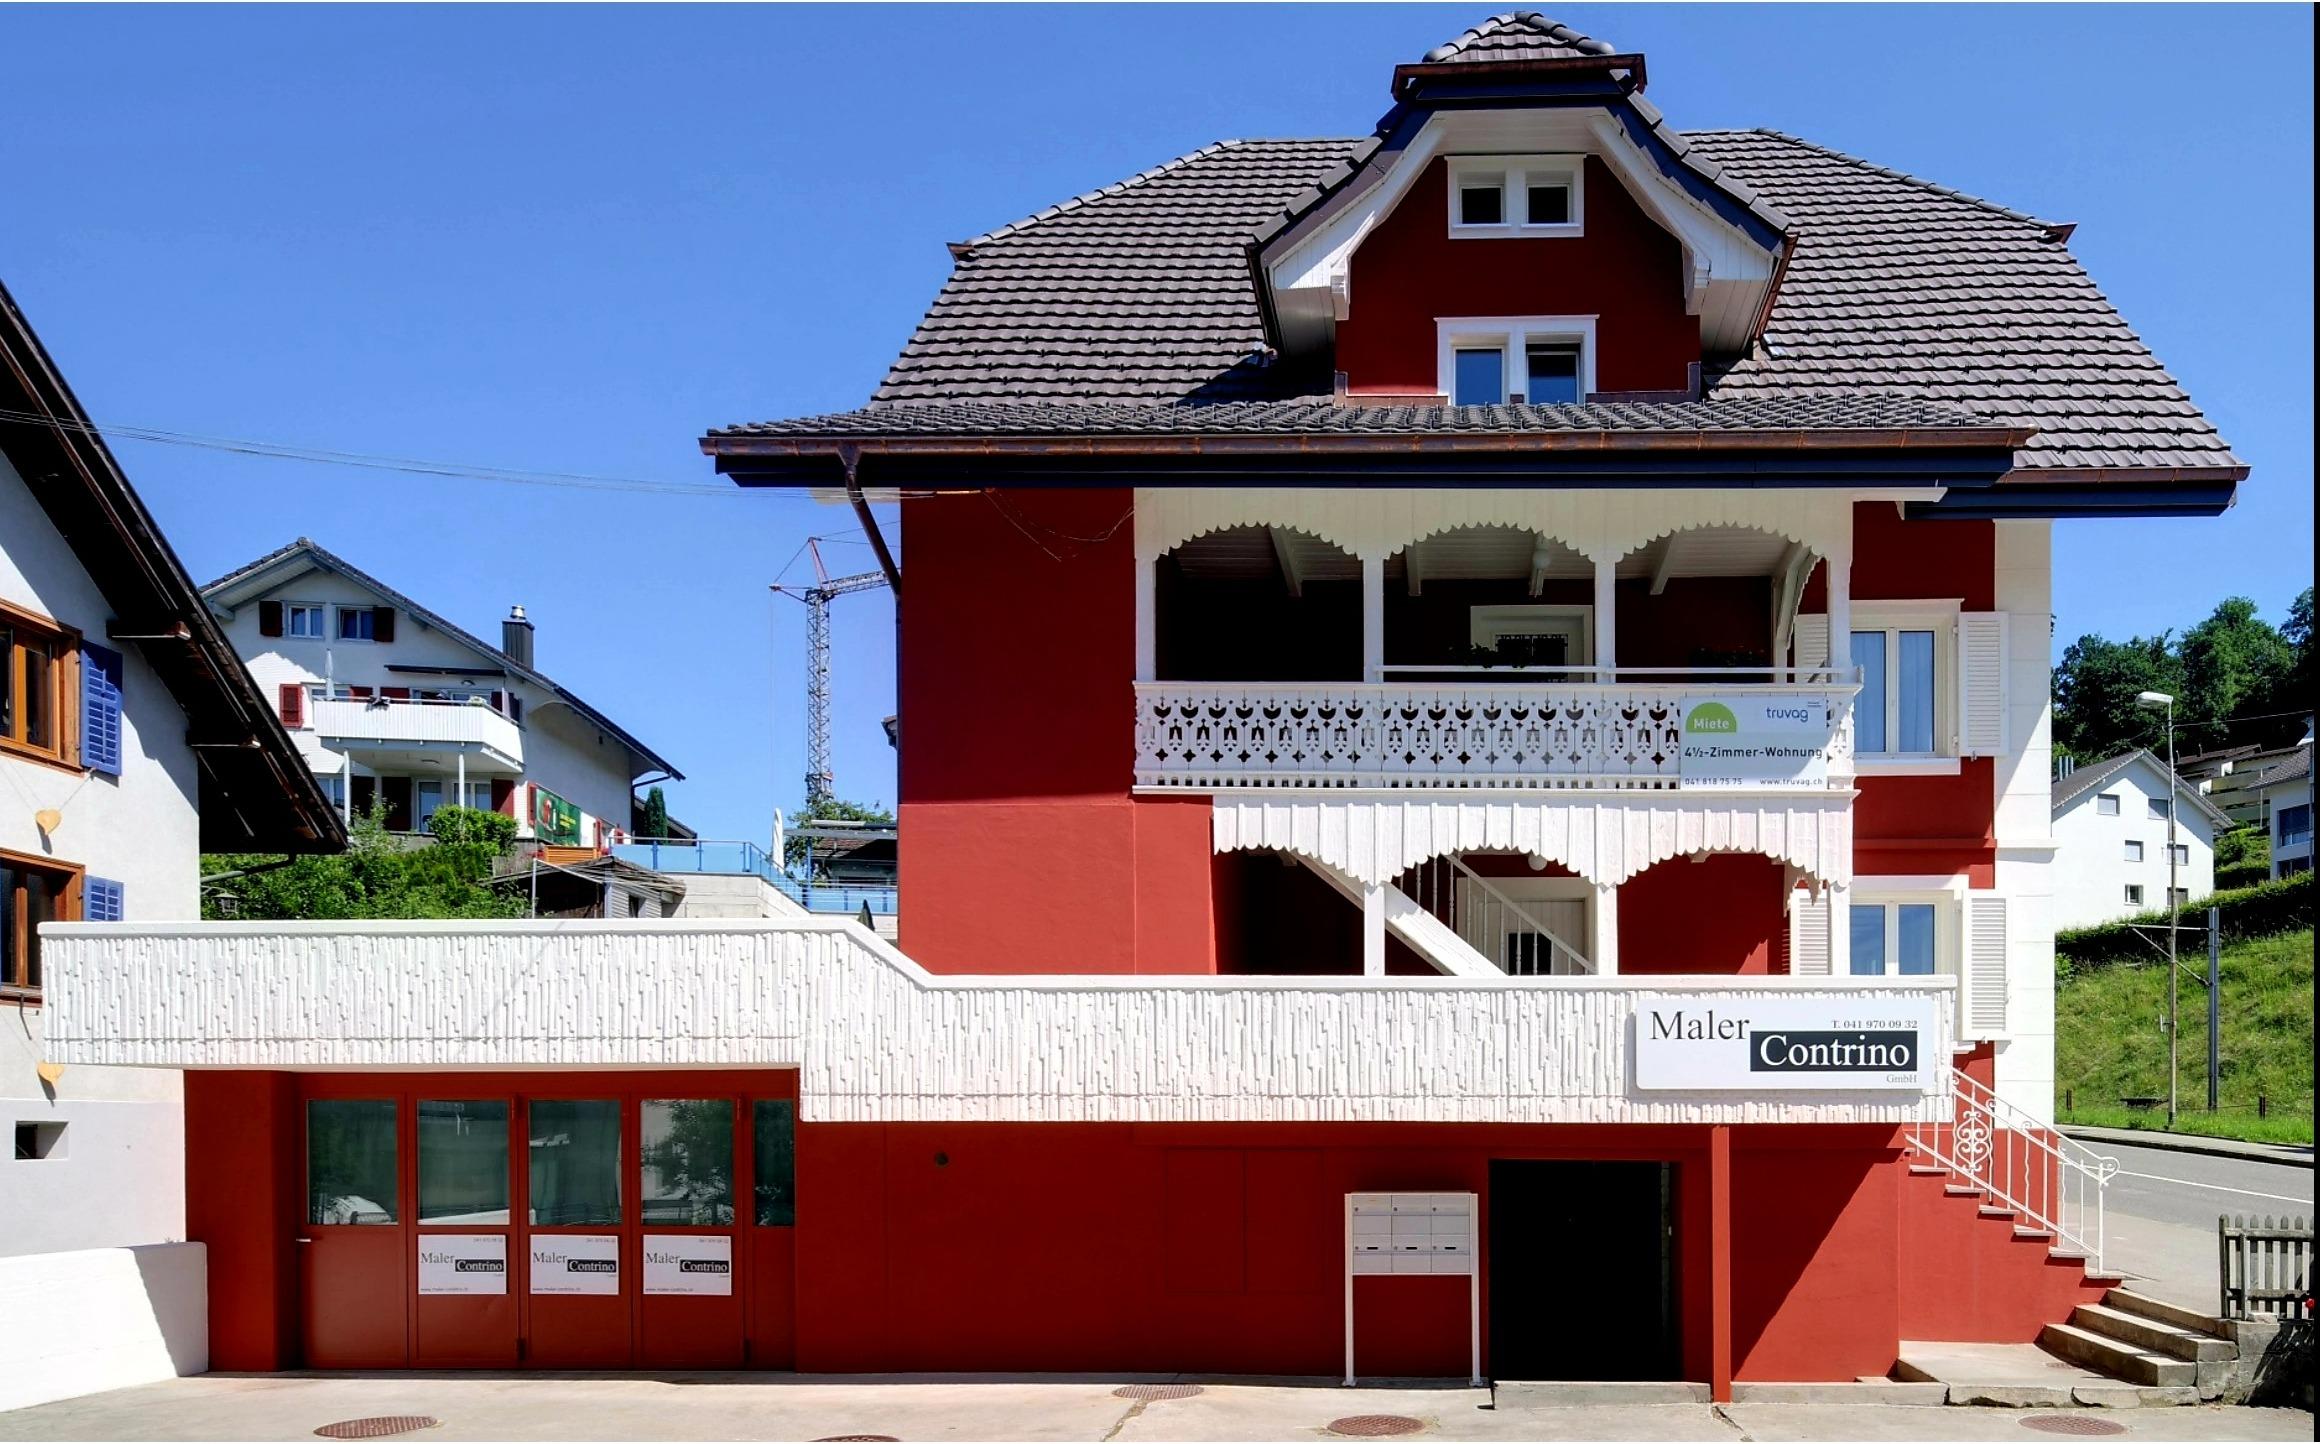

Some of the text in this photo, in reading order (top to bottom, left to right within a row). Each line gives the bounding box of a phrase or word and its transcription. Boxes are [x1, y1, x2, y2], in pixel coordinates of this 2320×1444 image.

[1766, 707, 1809, 722] truvag
[1693, 717, 1730, 729] Miete
[1684, 746, 1823, 759] 4½-Zimmer-Wohnung
[1685, 777, 1743, 785] 041 818 75 75
[1760, 777, 1823, 786] www.truvag.ch
[1649, 1010, 1750, 1040] Maler
[1843, 1020, 1862, 1029] 041
[1865, 1020, 1886, 1029] 970
[1888, 1020, 1902, 1029] 09
[1904, 1020, 1918, 1029] 32
[1760, 1033, 1910, 1067] Contrino
[1886, 1074, 1917, 1083] GmbH
[421, 1252, 455, 1264] Maler
[533, 1252, 567, 1263] Maler
[646, 1252, 680, 1264] Maler
[456, 1260, 503, 1272] Contrino
[569, 1260, 615, 1272] Contrino
[681, 1261, 728, 1272] Contrino
